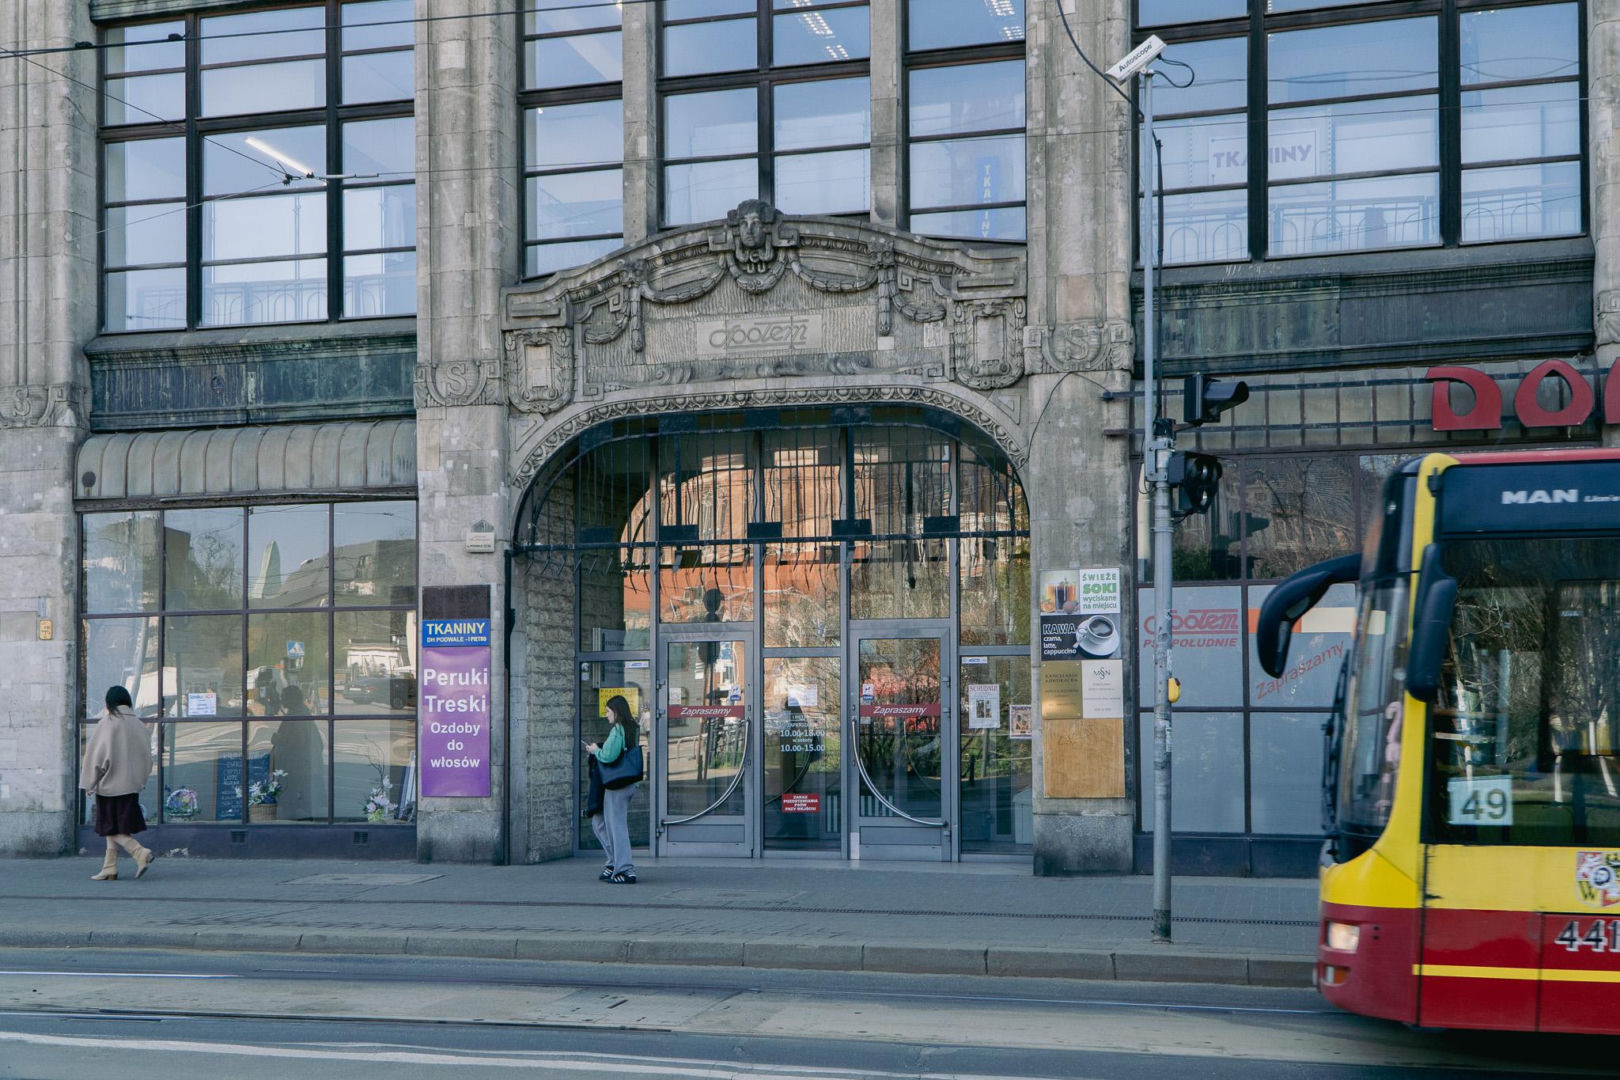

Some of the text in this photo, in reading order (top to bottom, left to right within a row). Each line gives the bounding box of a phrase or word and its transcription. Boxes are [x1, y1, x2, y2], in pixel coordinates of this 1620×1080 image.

[1119, 44, 1153, 72] Autoscope
[1426, 357, 1620, 431] DO
[1502, 489, 1578, 505] MAN
[1082, 572, 1117, 581] ŚWIEŻE
[1082, 583, 1117, 594] SOKI
[1092, 602, 1117, 610] miejscu
[426, 622, 486, 635] TKANINY
[1042, 622, 1076, 635] KAWA
[1171, 638, 1239, 648] POŁUDNIE
[1043, 648, 1077, 656] cappuccino
[1256, 640, 1345, 700] Zapraszamy
[423, 667, 488, 686] Peruki
[424, 695, 487, 713] Treski
[680, 707, 732, 717] Zapraszamy
[873, 706, 927, 716] Zapraszamy
[430, 721, 480, 736] Ozdoby
[780, 729, 825, 737] 10.00-18.00
[447, 739, 464, 751] do
[780, 744, 826, 752] 10.00-15.00
[430, 756, 480, 768] włosów
[1461, 788, 1508, 820] 49
